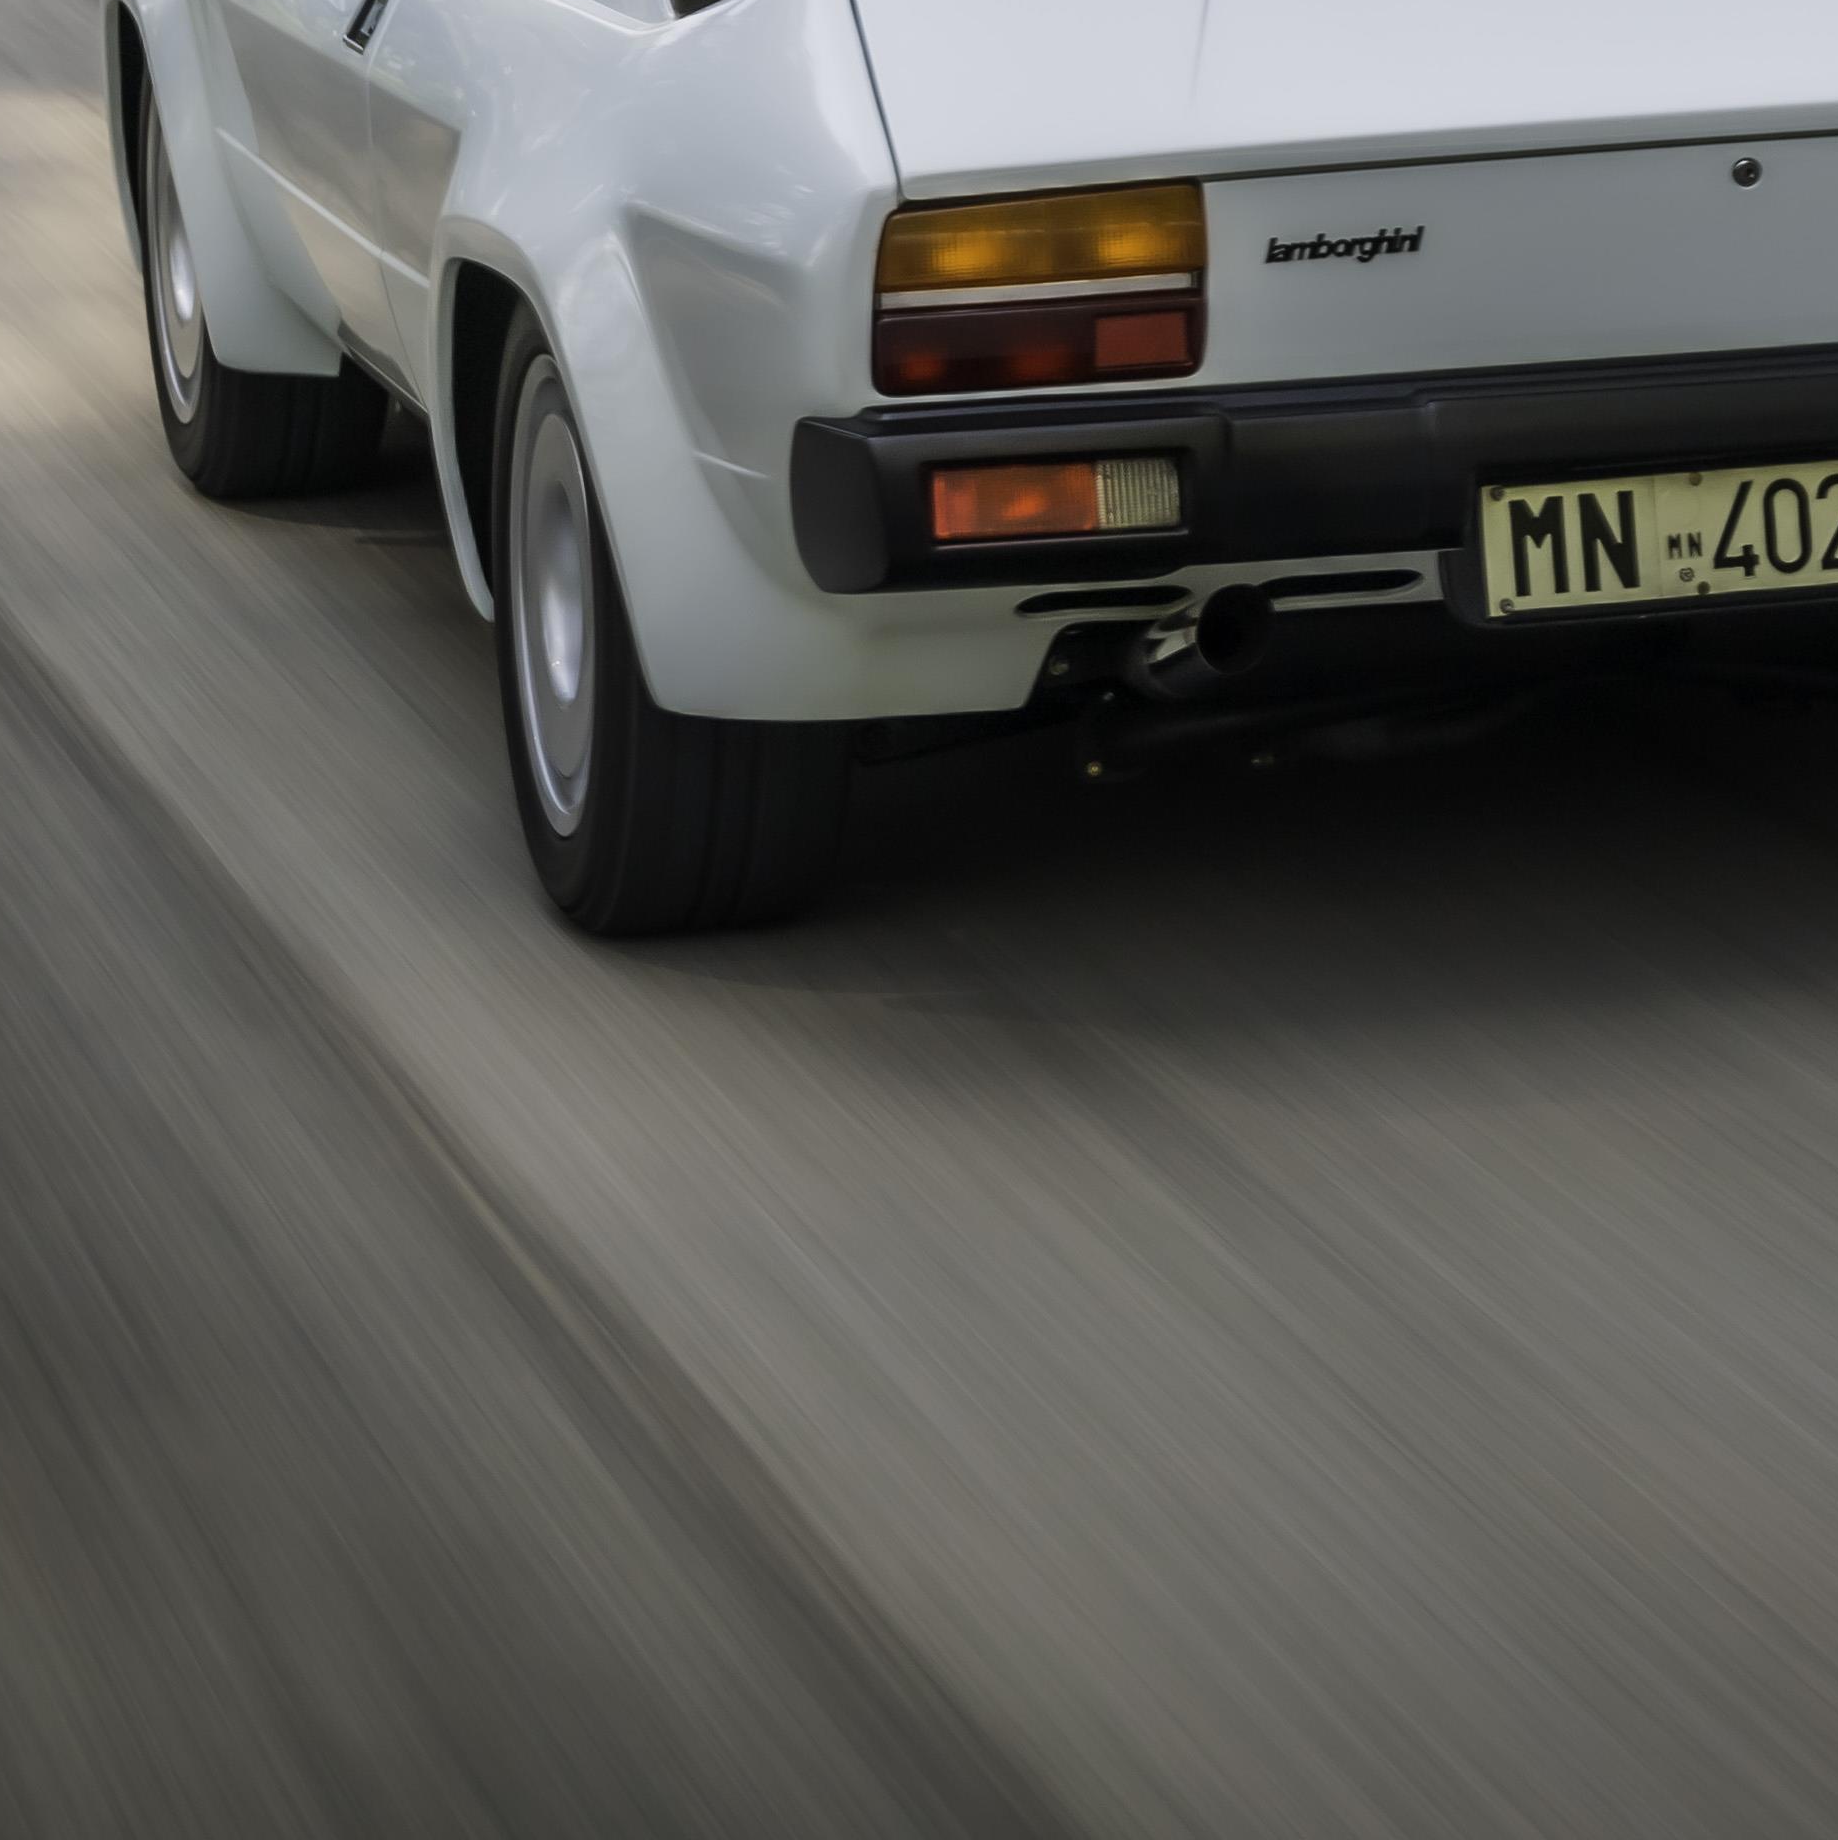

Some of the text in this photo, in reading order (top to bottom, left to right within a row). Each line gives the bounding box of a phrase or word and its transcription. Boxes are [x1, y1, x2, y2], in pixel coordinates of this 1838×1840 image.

[1266, 225, 1425, 262] lamborghini
[1509, 489, 1640, 597] MN
[1667, 531, 1702, 559] MN
